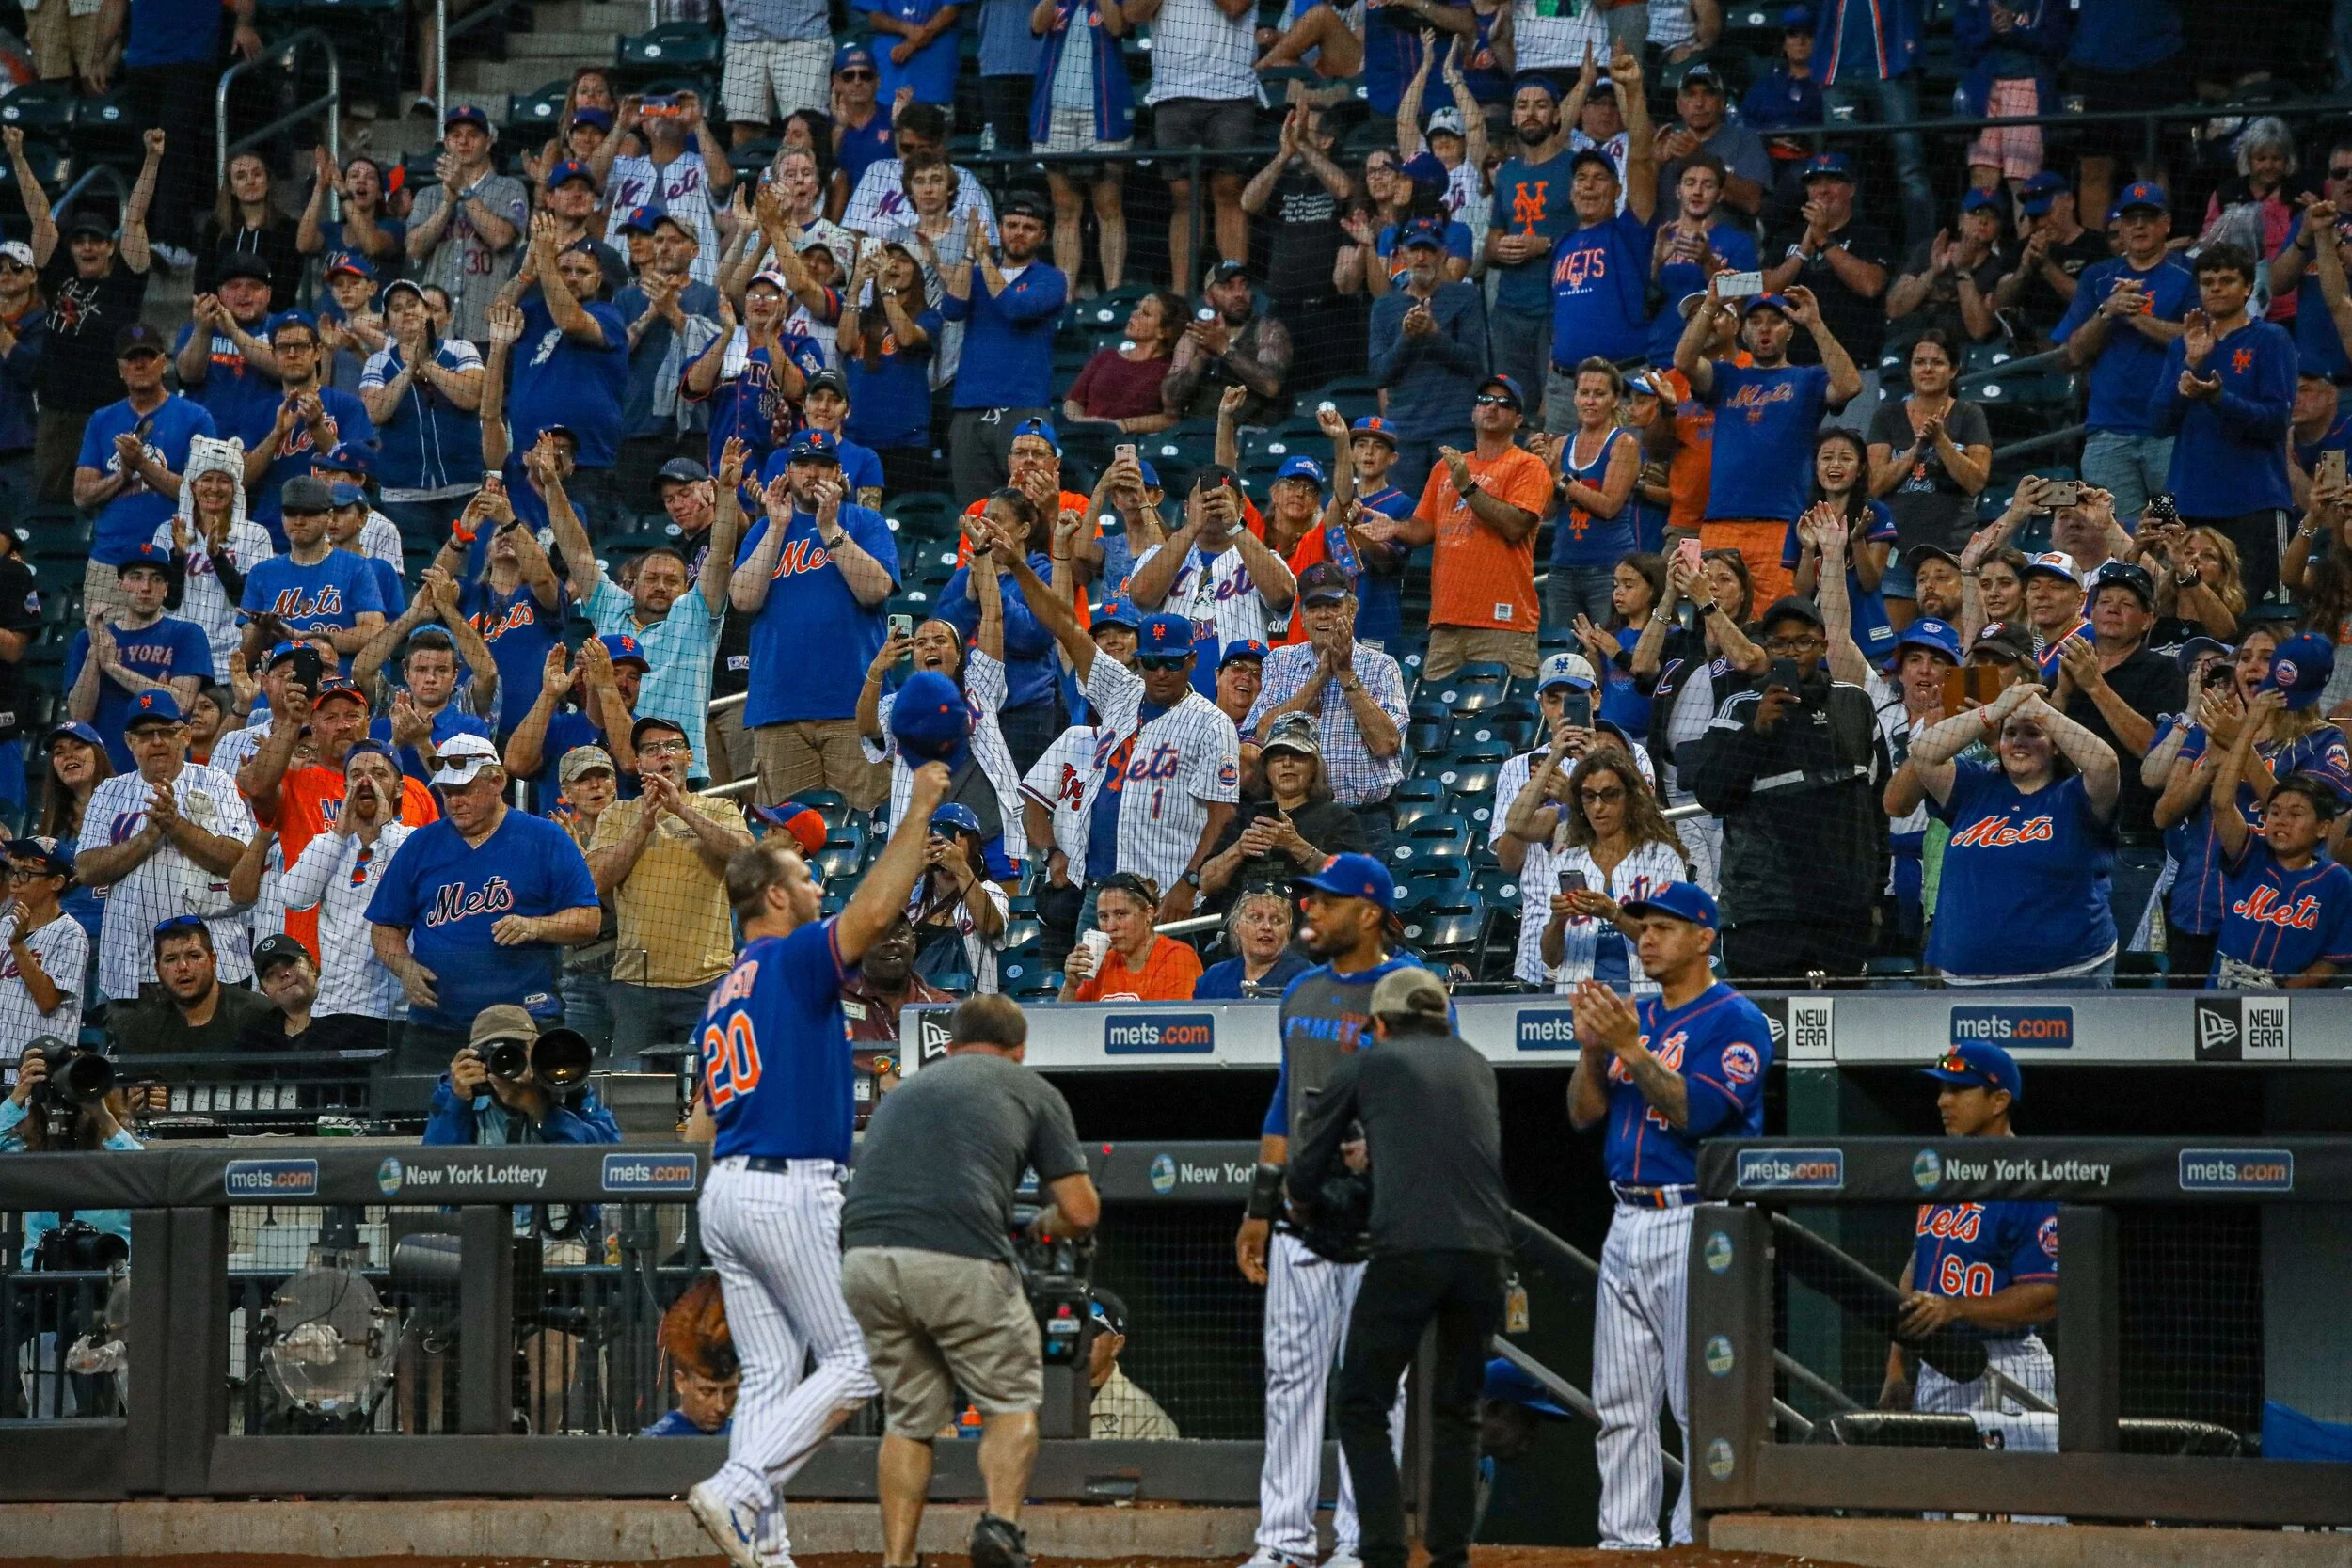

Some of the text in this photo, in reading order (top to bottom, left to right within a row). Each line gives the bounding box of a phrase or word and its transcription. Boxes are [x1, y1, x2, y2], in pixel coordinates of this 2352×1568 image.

[465, 250, 493, 276] 30
[1552, 247, 1605, 286] METS
[772, 537, 837, 580] Me
[269, 584, 343, 621] Mets
[1554, 657, 1569, 674] NY
[1152, 786, 1162, 820] 1
[1951, 815, 2055, 847] Mets
[426, 875, 515, 928] Mets
[2233, 883, 2322, 931] Mets
[1521, 1018, 1574, 1041] mets
[1795, 1009, 1827, 1027] NEW
[1956, 1016, 2069, 1038] mets.com
[2249, 1009, 2284, 1027] NEW
[1109, 1022, 1210, 1044] mets.com
[1795, 1028, 1827, 1047] ERA
[2249, 1029, 2284, 1048] ERA
[703, 1008, 763, 1113] 20
[231, 1170, 313, 1188] mets.com
[405, 1166, 442, 1185] New
[447, 1165, 483, 1184] York
[487, 1164, 547, 1189] Lottery
[608, 1163, 691, 1182] mets.com
[1180, 1163, 1220, 1184] New
[1743, 1160, 1837, 1179] mets.com
[1945, 1159, 1988, 1182] New
[1993, 1159, 2037, 1182] York
[2042, 1158, 2111, 1187] Lottery
[2186, 1162, 2287, 1181] mets.com
[1939, 1253, 1994, 1298] 60
